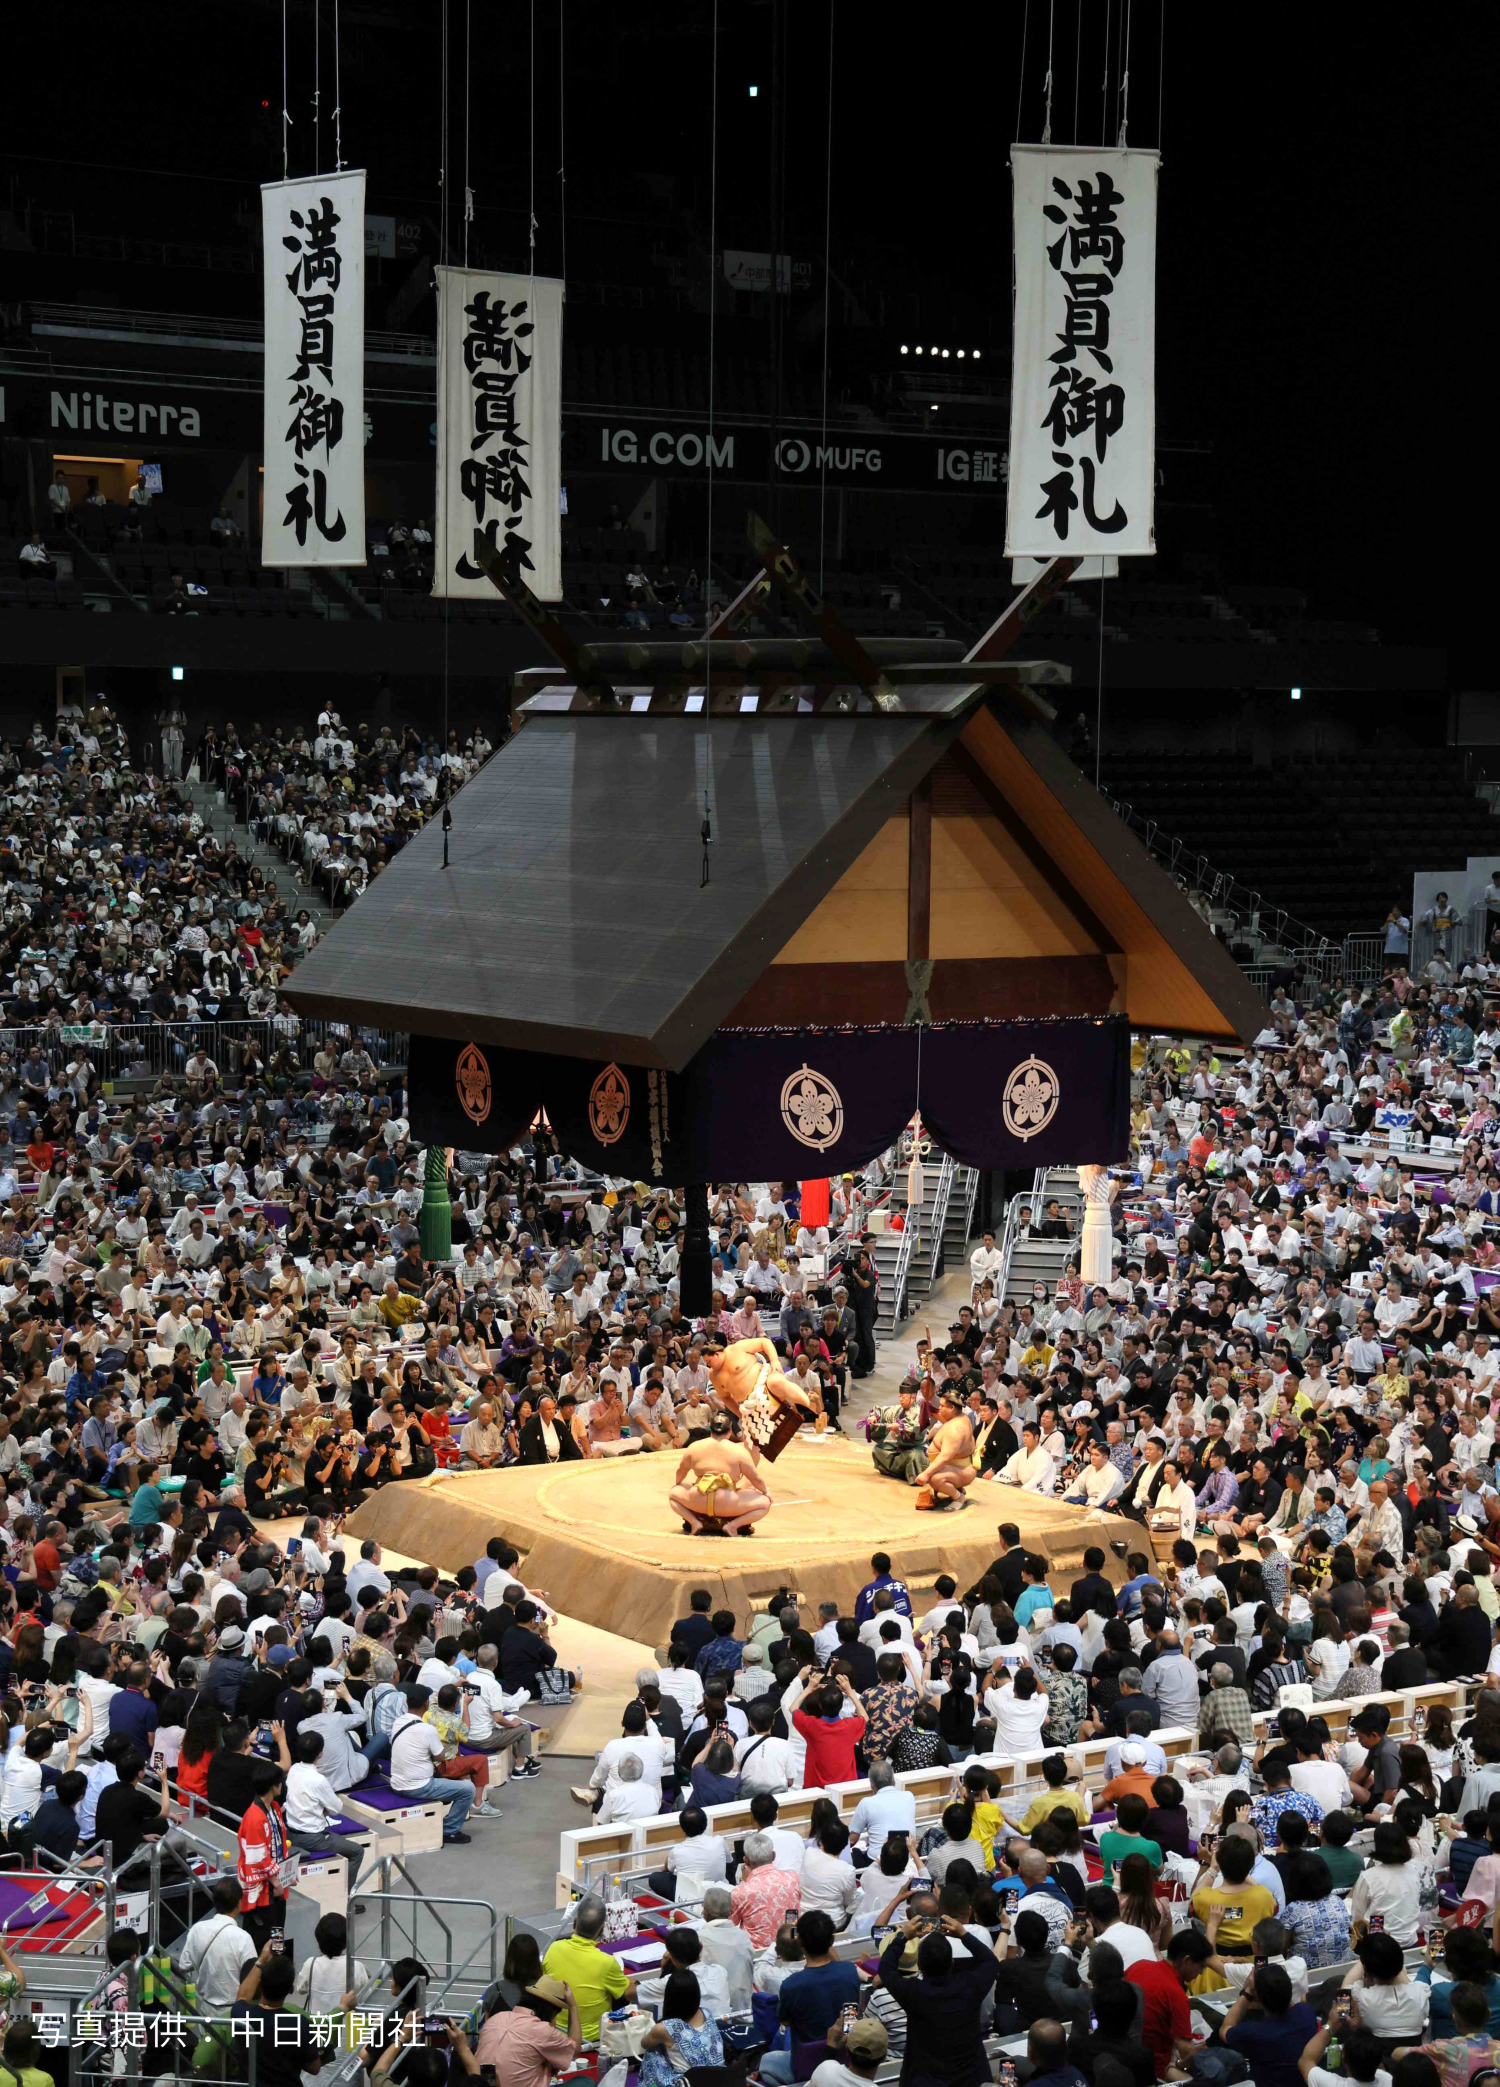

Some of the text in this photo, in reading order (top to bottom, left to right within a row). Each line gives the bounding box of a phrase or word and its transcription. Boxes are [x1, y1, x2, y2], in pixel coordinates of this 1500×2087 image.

[397, 225, 422, 240] 402
[792, 262, 812, 276] 401
[282, 196, 347, 546] 満員御礼
[1034, 171, 1128, 540] 満員御礼
[50, 391, 201, 437] Niterra
[601, 428, 735, 469] IG.COM
[815, 446, 882, 472] MUFG
